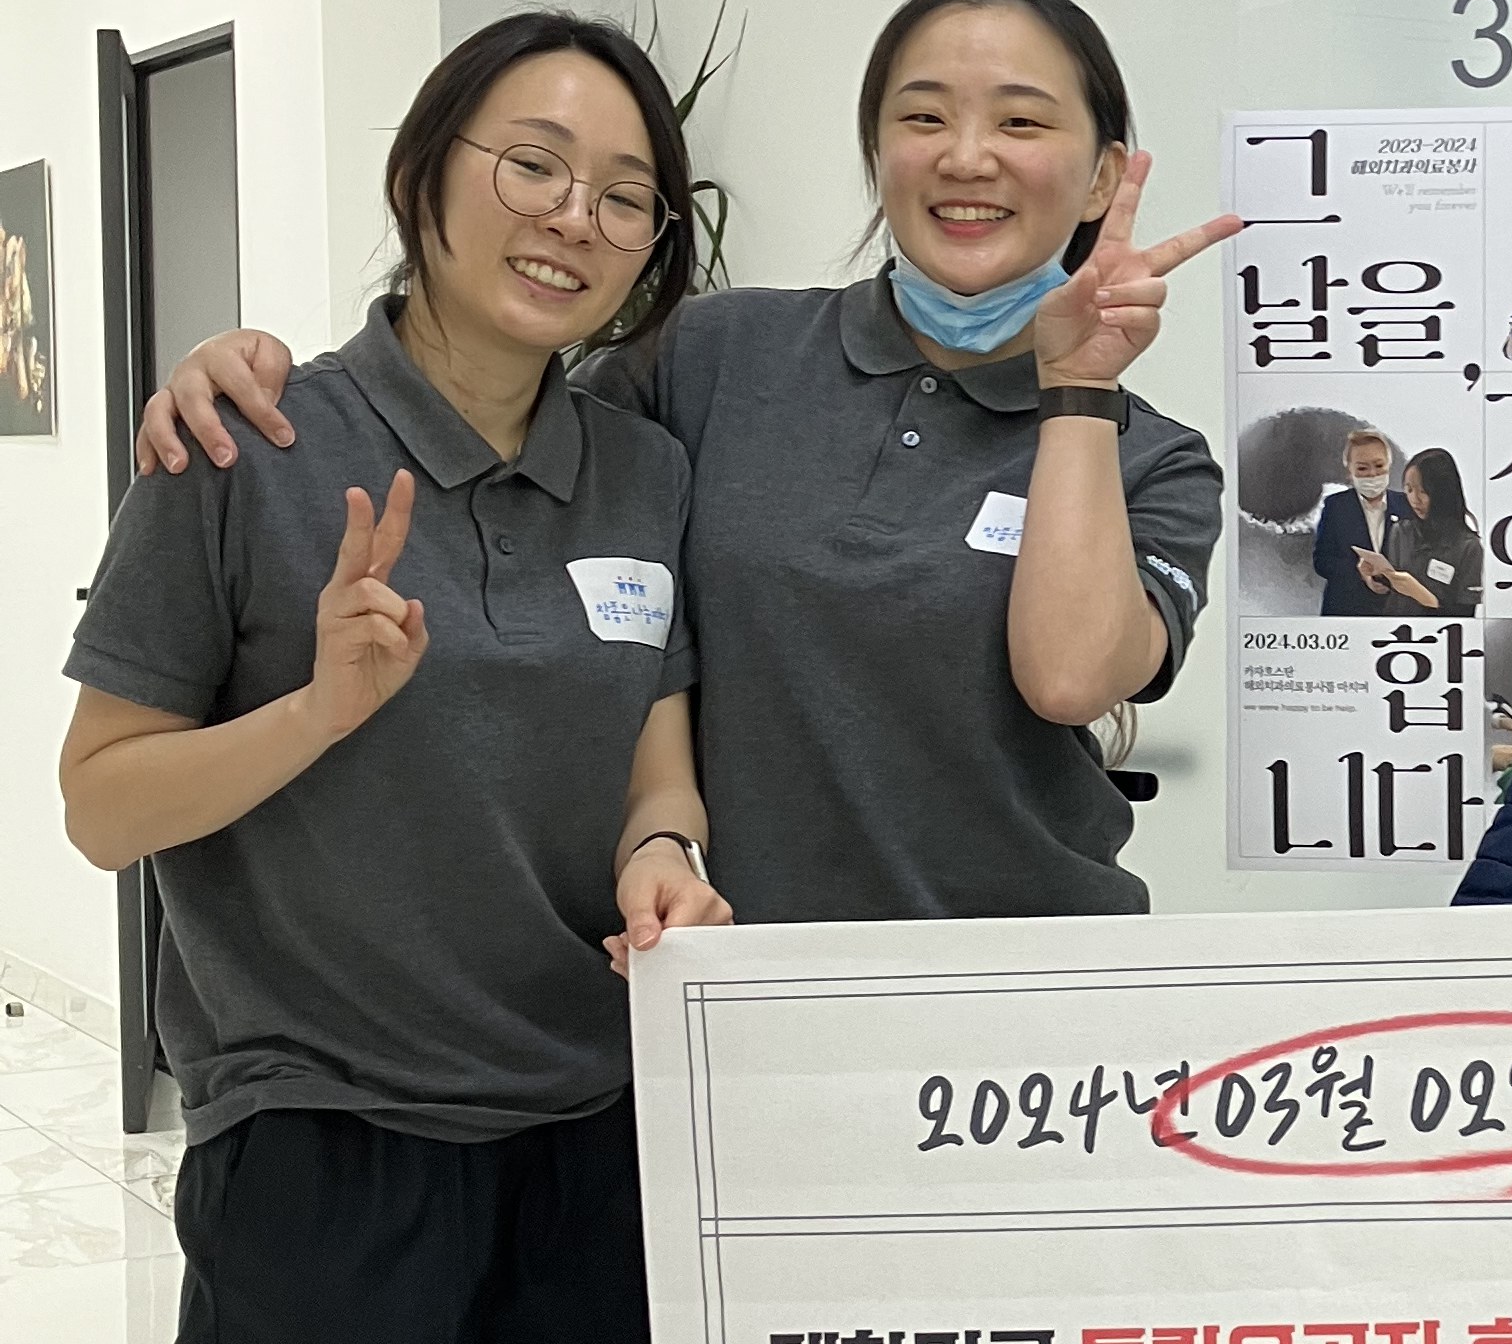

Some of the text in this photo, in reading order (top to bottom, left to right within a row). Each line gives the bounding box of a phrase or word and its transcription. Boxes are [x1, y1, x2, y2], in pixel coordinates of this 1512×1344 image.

[1378, 137, 1478, 154] 2023-2024
[1243, 632, 1350, 651] 2024.03.02
[918, 1061, 1199, 1153] 2024년
[1214, 1046, 1386, 1151] 03월
